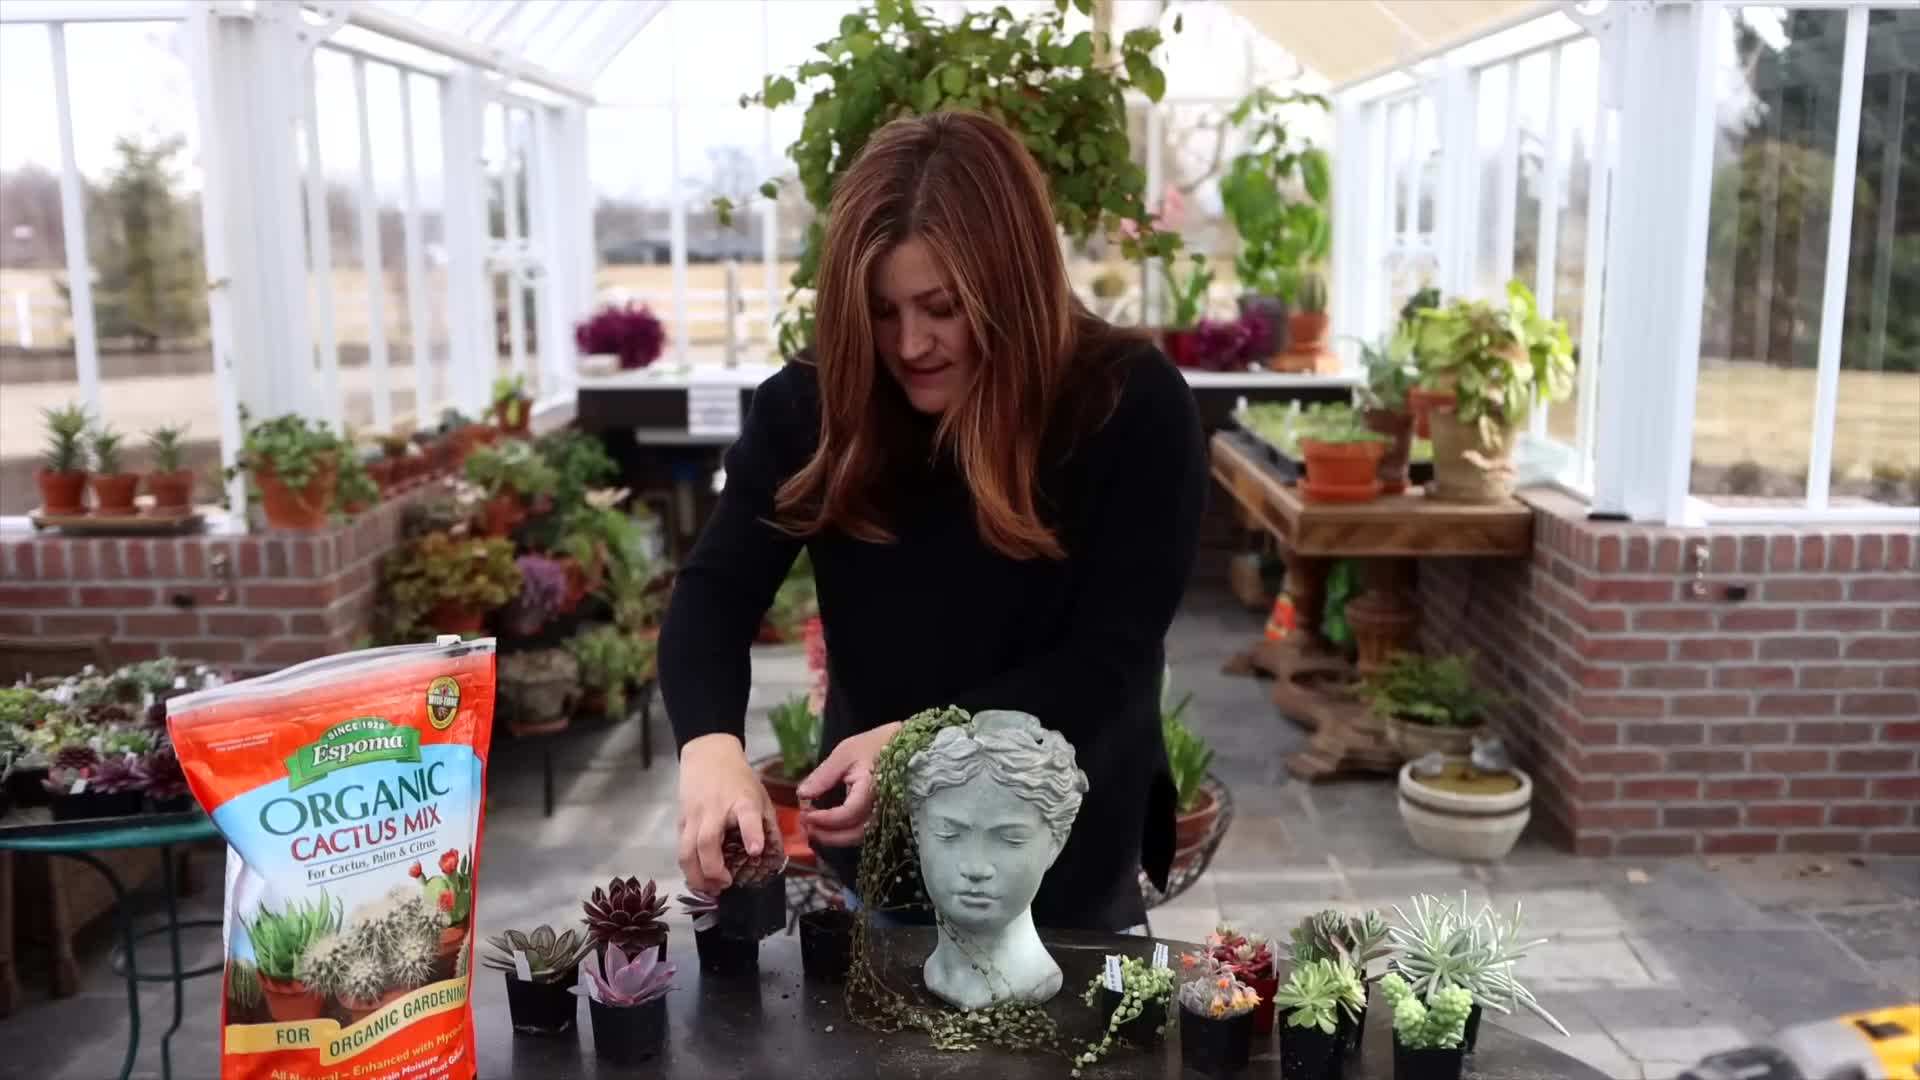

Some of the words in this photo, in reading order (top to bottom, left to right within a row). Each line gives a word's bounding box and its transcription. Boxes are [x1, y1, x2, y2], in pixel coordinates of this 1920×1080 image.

[312, 735, 403, 766] Espoma
[328, 721, 358, 740] SINCE
[259, 761, 449, 836] ORGANIC
[290, 817, 397, 861] CACTUS
[404, 803, 442, 836] MIX
[307, 869, 326, 880] For
[330, 860, 369, 874] Cactus,
[372, 850, 396, 865] Palm
[399, 848, 406, 857] &
[409, 840, 436, 852] Citrus
[276, 1028, 310, 1044] FOR
[329, 1009, 399, 1057] ORGANIC
[352, 1049, 410, 1076] Enhanced
[412, 1040, 434, 1057] with
